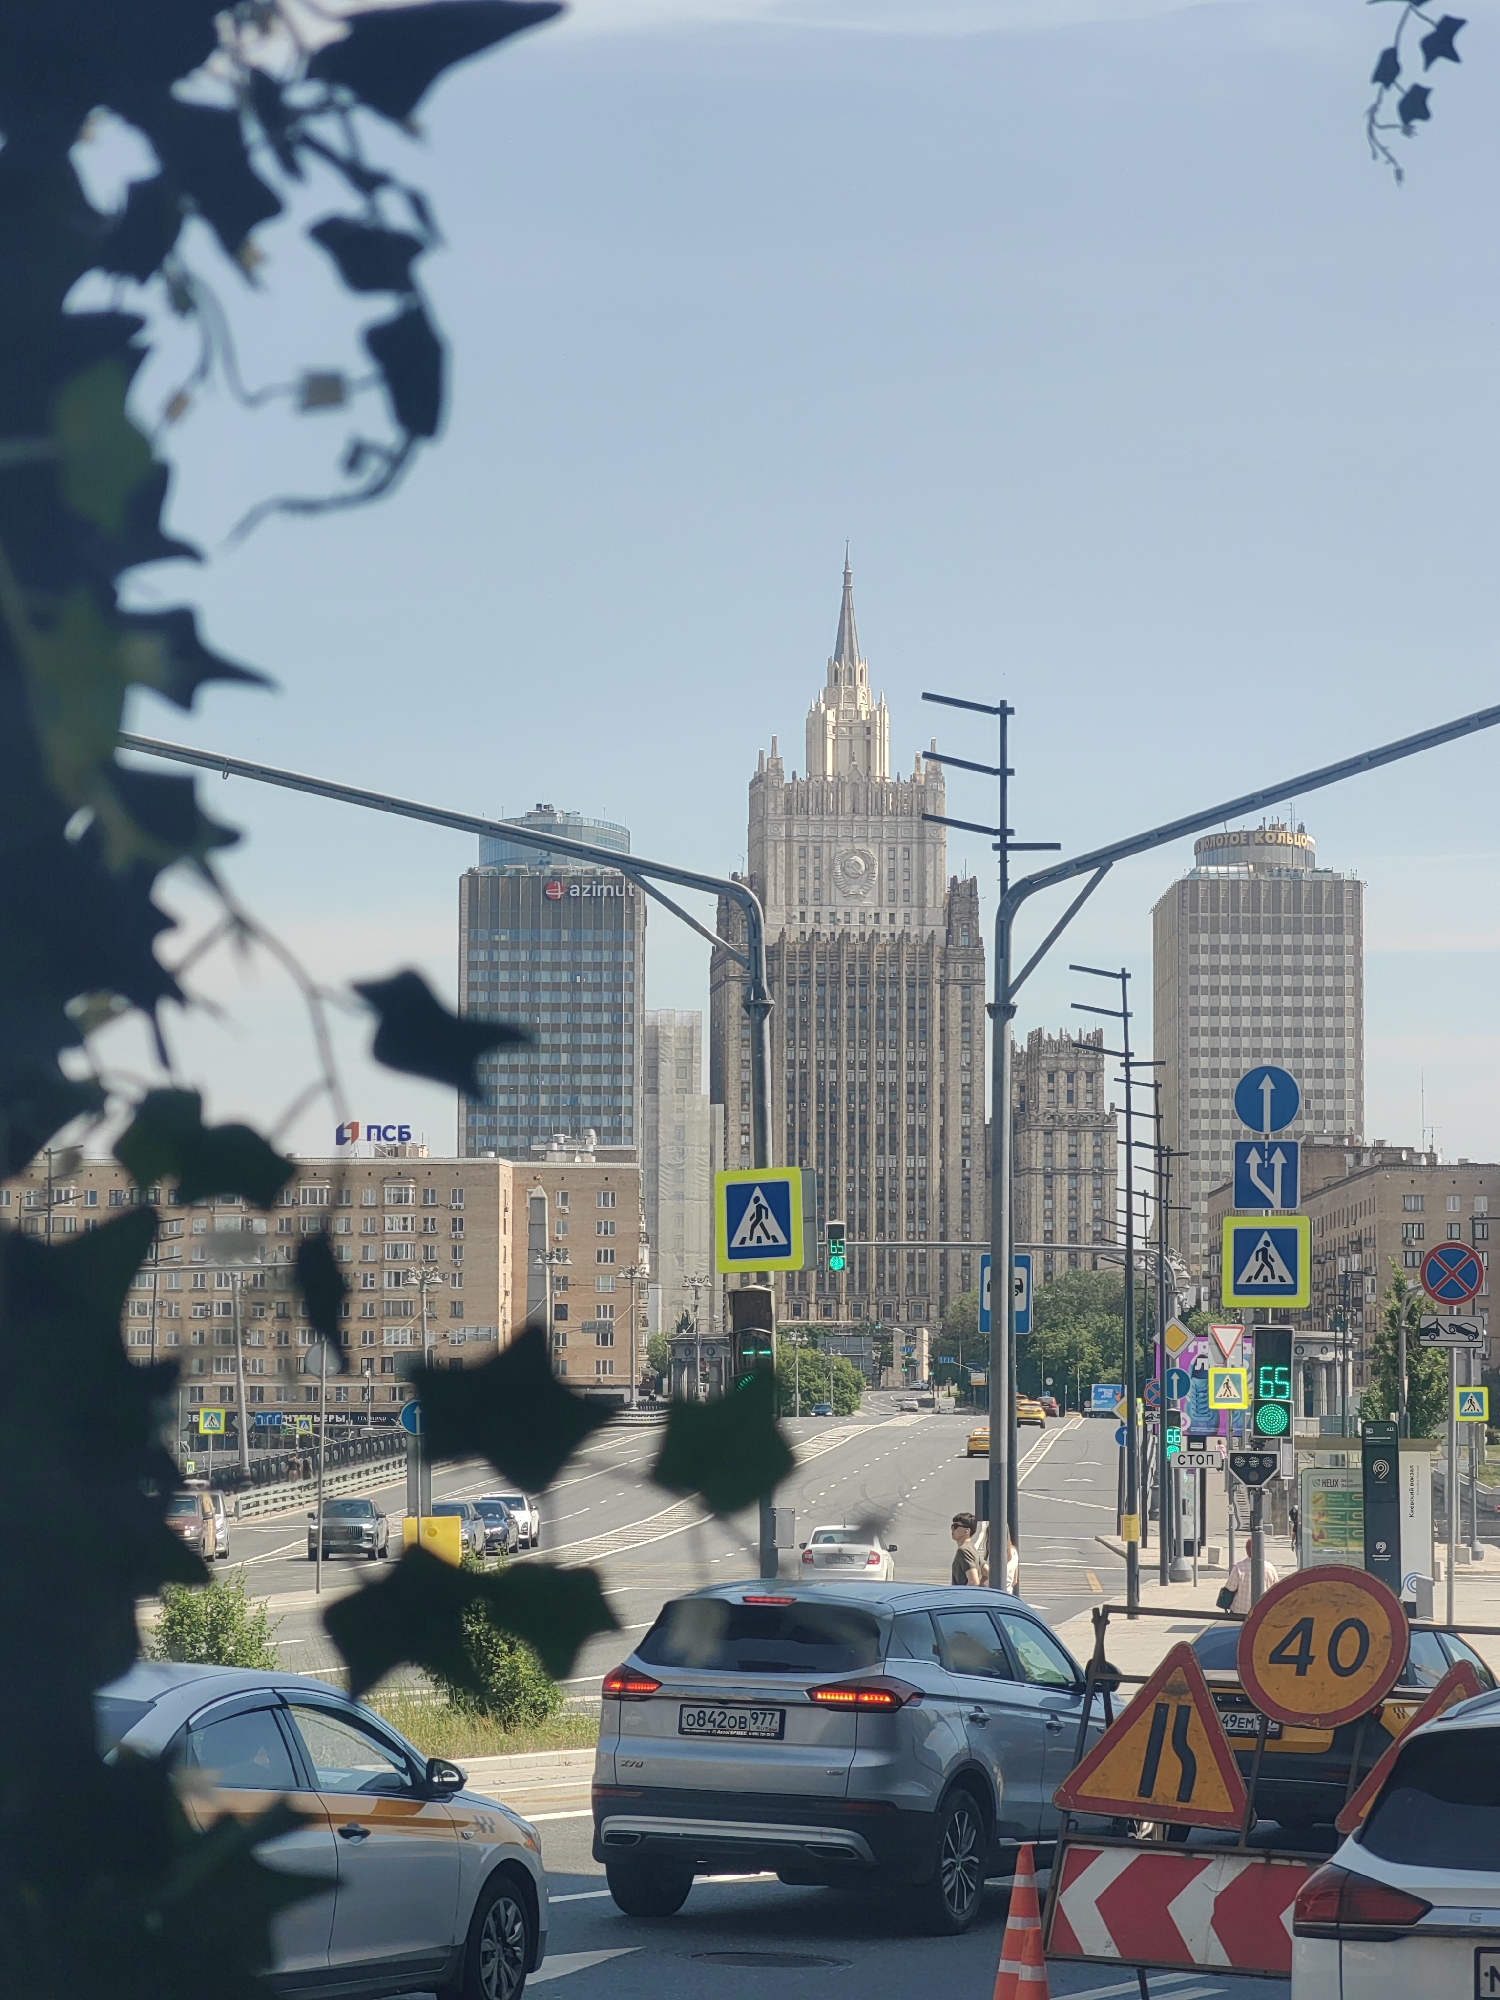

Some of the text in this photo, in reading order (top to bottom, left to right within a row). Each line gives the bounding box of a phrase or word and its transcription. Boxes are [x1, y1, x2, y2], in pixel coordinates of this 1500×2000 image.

[1254, 832, 1307, 848] КОЛЬЦО
[569, 881, 635, 897] azimut
[366, 1125, 412, 1142] ПСБ
[830, 1240, 844, 1254] 65
[1259, 1366, 1290, 1398] 65
[1166, 1428, 1181, 1443] 66
[1177, 1454, 1214, 1466] СТОП
[1321, 1479, 1339, 1488] HELIX
[1268, 1616, 1370, 1678] 40
[750, 1711, 776, 1727] 977
[1221, 1713, 1255, 1729] 49ЕМ
